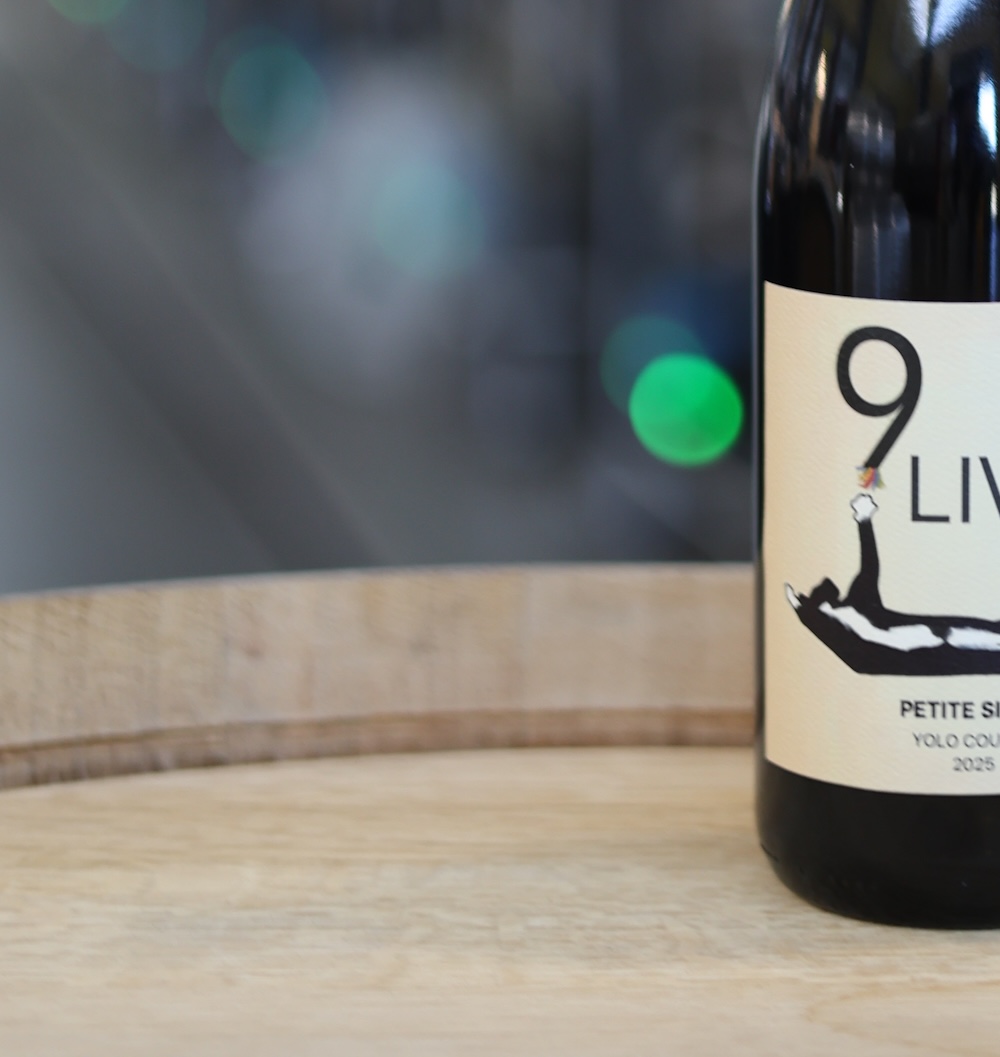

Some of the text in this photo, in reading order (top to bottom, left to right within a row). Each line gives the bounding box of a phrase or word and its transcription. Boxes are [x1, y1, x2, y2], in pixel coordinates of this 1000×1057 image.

[835, 325, 923, 469] 9
[900, 699, 975, 719] PETITE
[912, 732, 960, 749] YOLO
[952, 756, 996, 772] 2025
